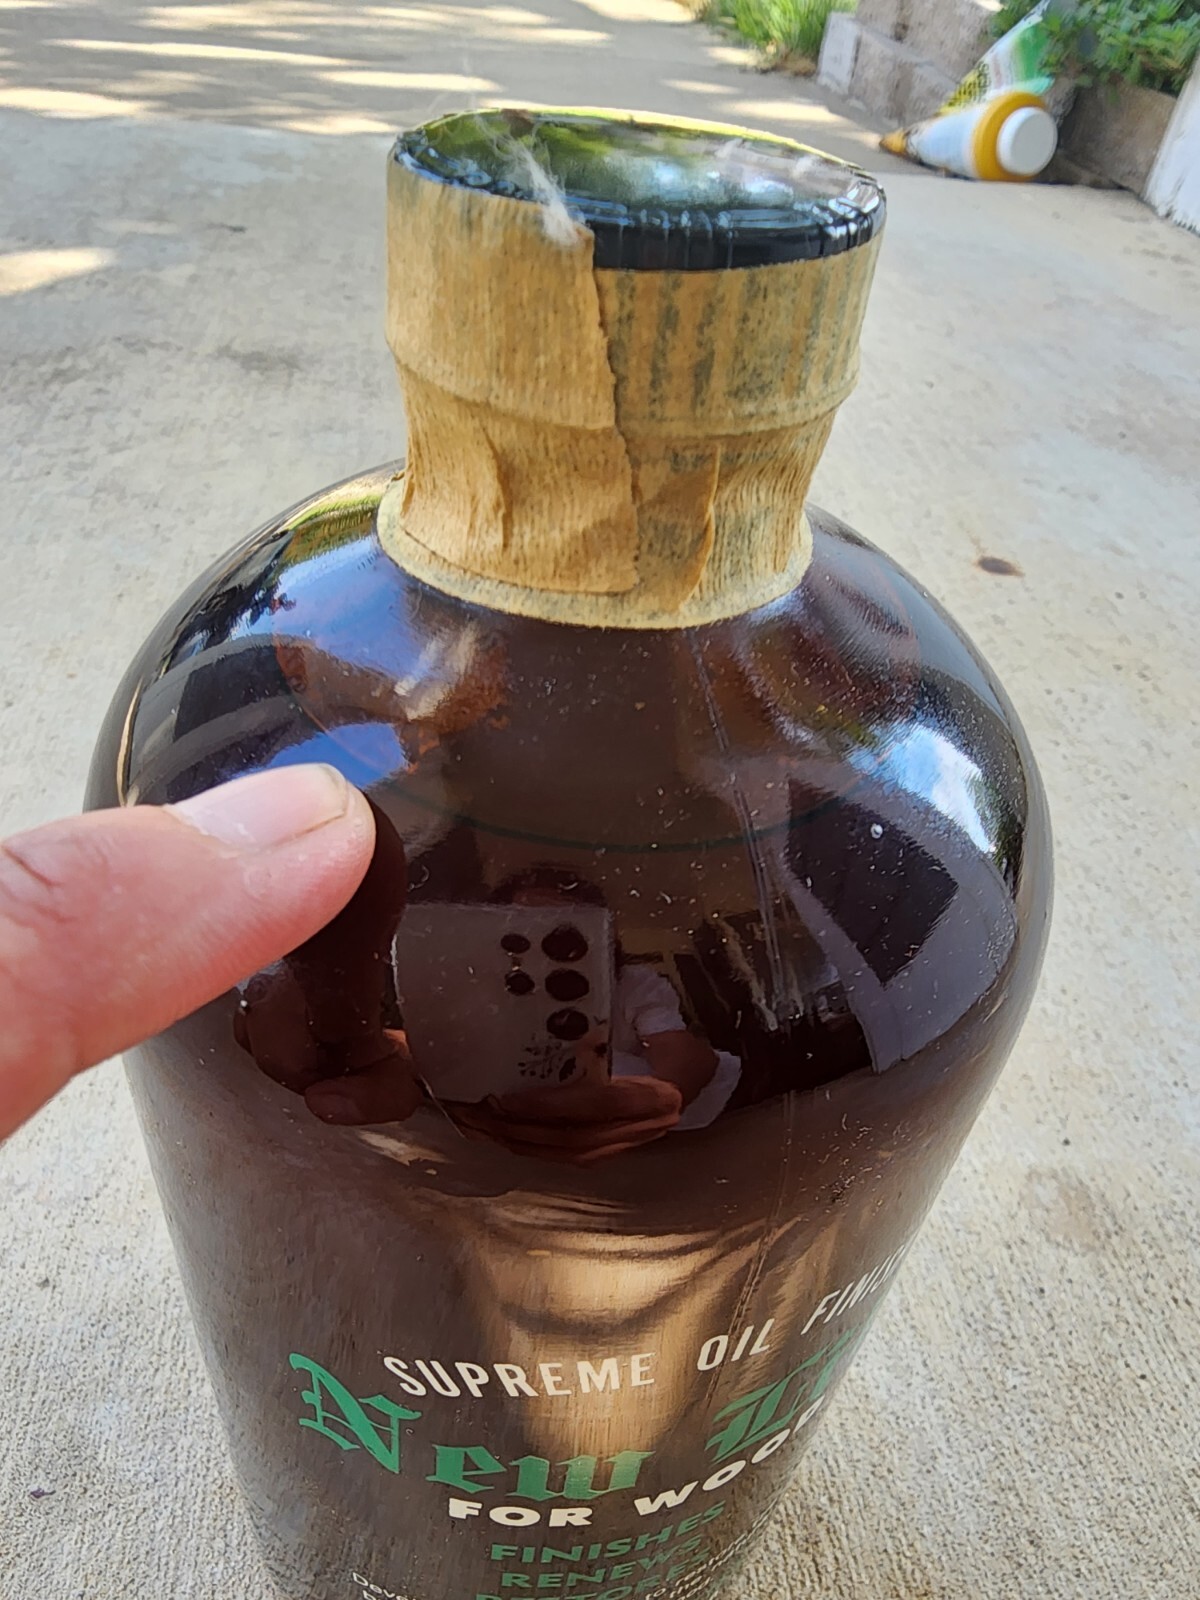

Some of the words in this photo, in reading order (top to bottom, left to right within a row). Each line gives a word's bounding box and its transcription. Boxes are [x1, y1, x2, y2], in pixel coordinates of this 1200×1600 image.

[384, 1352, 656, 1397] SUPREME
[697, 1318, 775, 1371] OIL
[800, 1244, 906, 1335] FINIS
[289, 1353, 655, 1501] New
[449, 1498, 592, 1527] FOR
[490, 1499, 727, 1564] FINISHES
[501, 1534, 702, 1588] RENEWS
